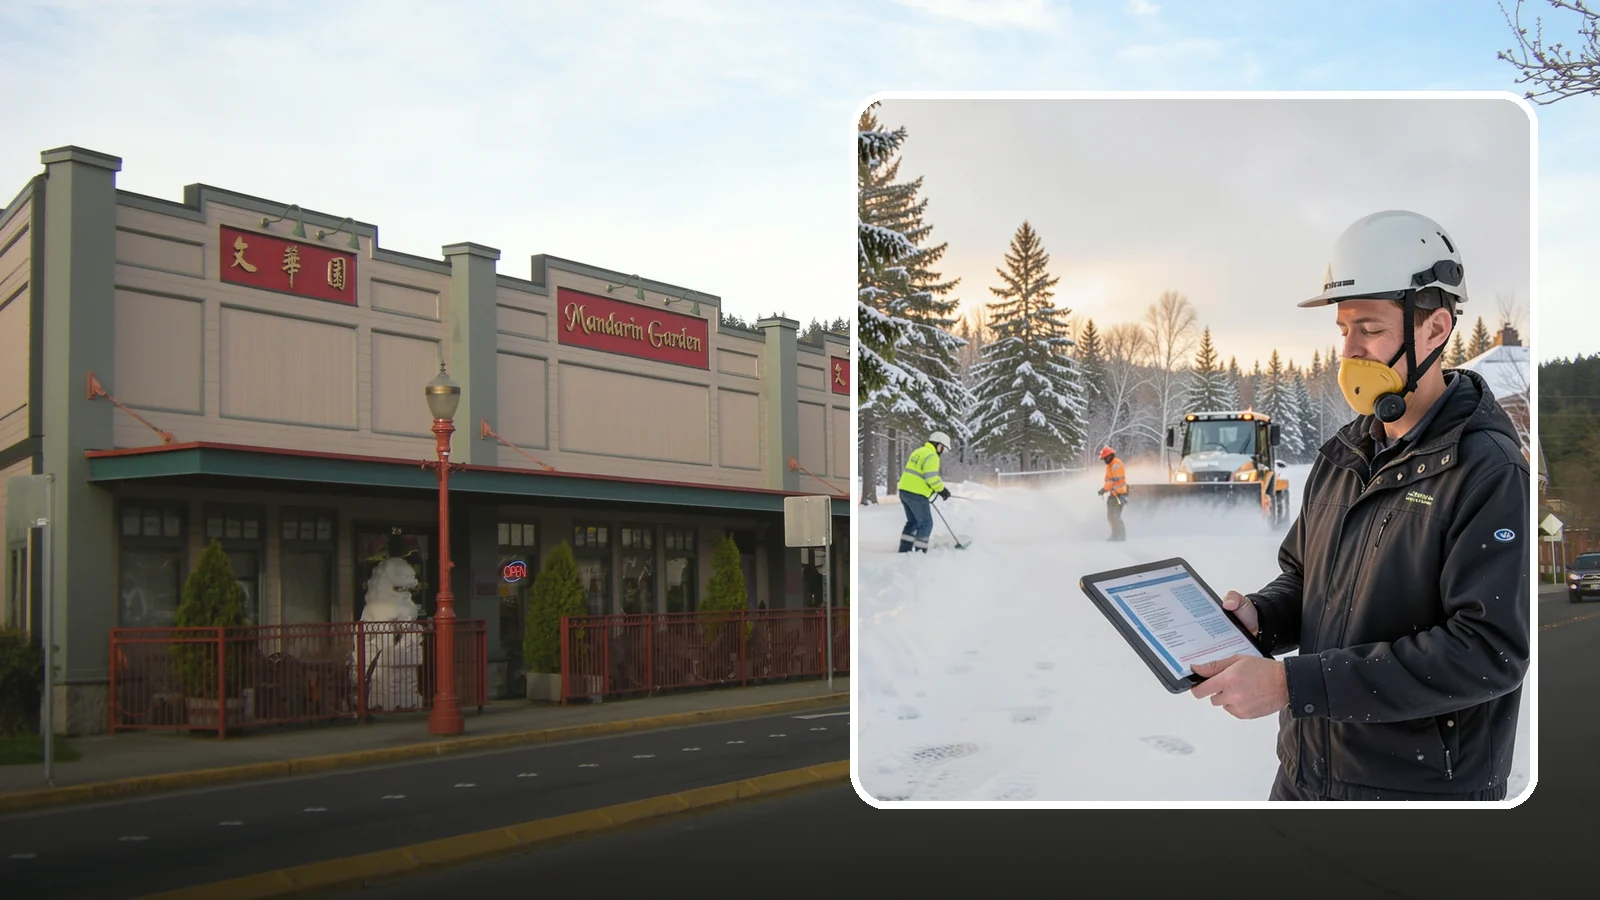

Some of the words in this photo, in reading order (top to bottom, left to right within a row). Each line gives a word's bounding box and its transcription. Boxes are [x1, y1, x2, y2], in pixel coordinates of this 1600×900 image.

[230, 235, 347, 290] 文華園
[564, 302, 644, 341] Mandarin
[648, 320, 701, 352] Garden
[503, 565, 527, 578] OPEN
